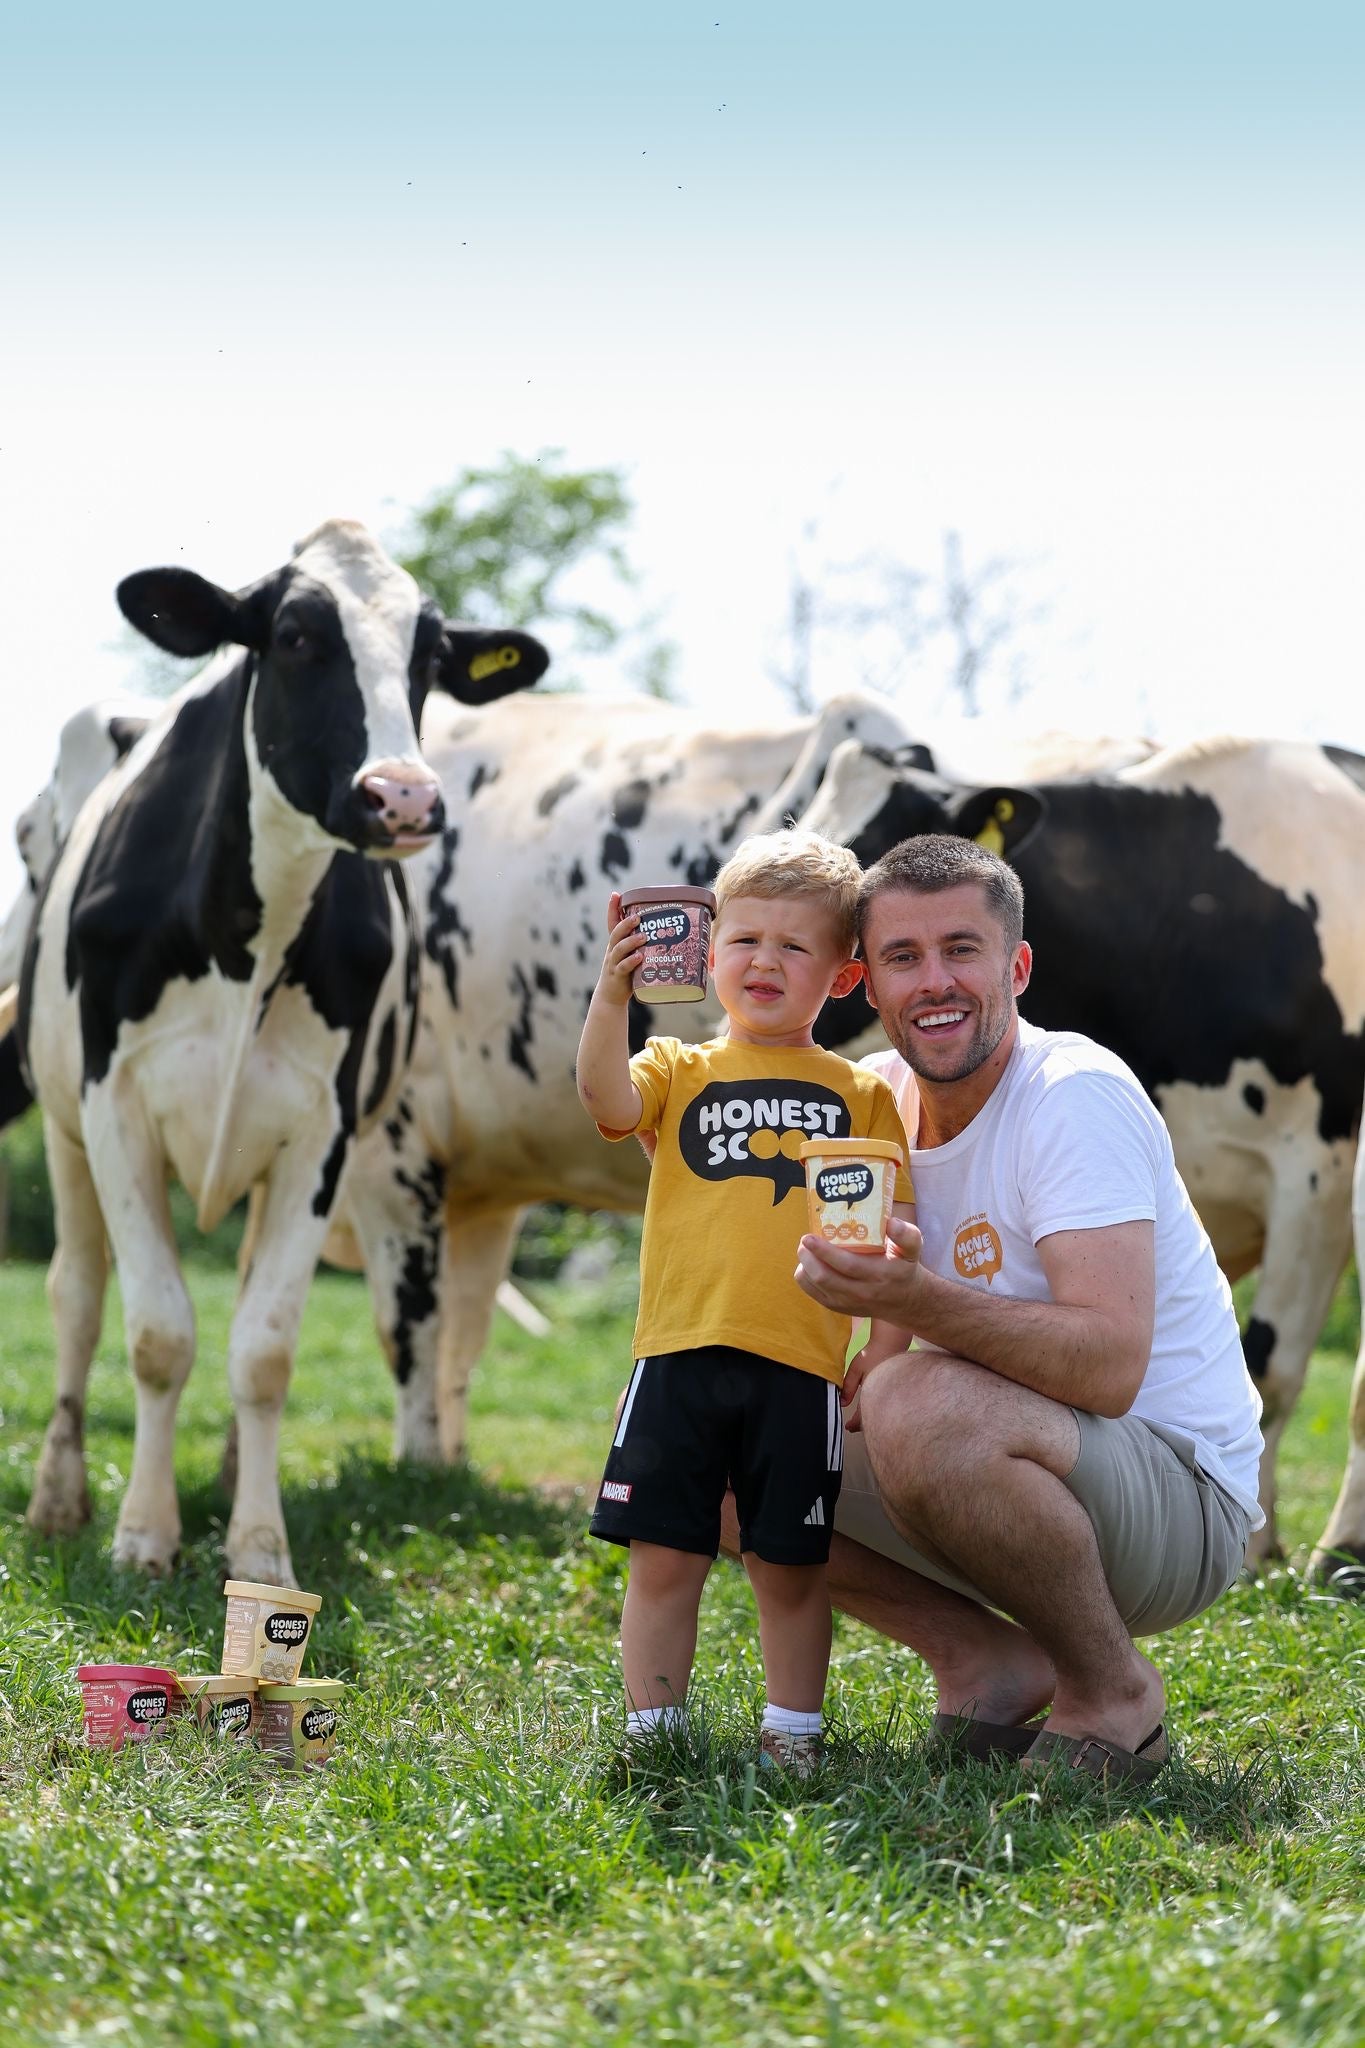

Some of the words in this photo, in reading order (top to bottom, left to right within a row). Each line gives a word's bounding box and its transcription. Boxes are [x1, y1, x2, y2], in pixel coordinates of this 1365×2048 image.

[640, 914, 685, 932] HONEST
[645, 955, 683, 963] CHOCOLATE
[699, 1098, 841, 1134] HONEST
[707, 1129, 829, 1166] SCOO
[820, 1170, 868, 1187] HONEST
[824, 1181, 867, 1198] SCOOP
[957, 1232, 992, 1258] HONE
[602, 1481, 630, 1501] MARVEL
[270, 1619, 307, 1630] HONEST
[272, 1629, 303, 1639] SCOOP
[132, 1697, 167, 1709] HONEST
[134, 1707, 164, 1719] SCOOP
